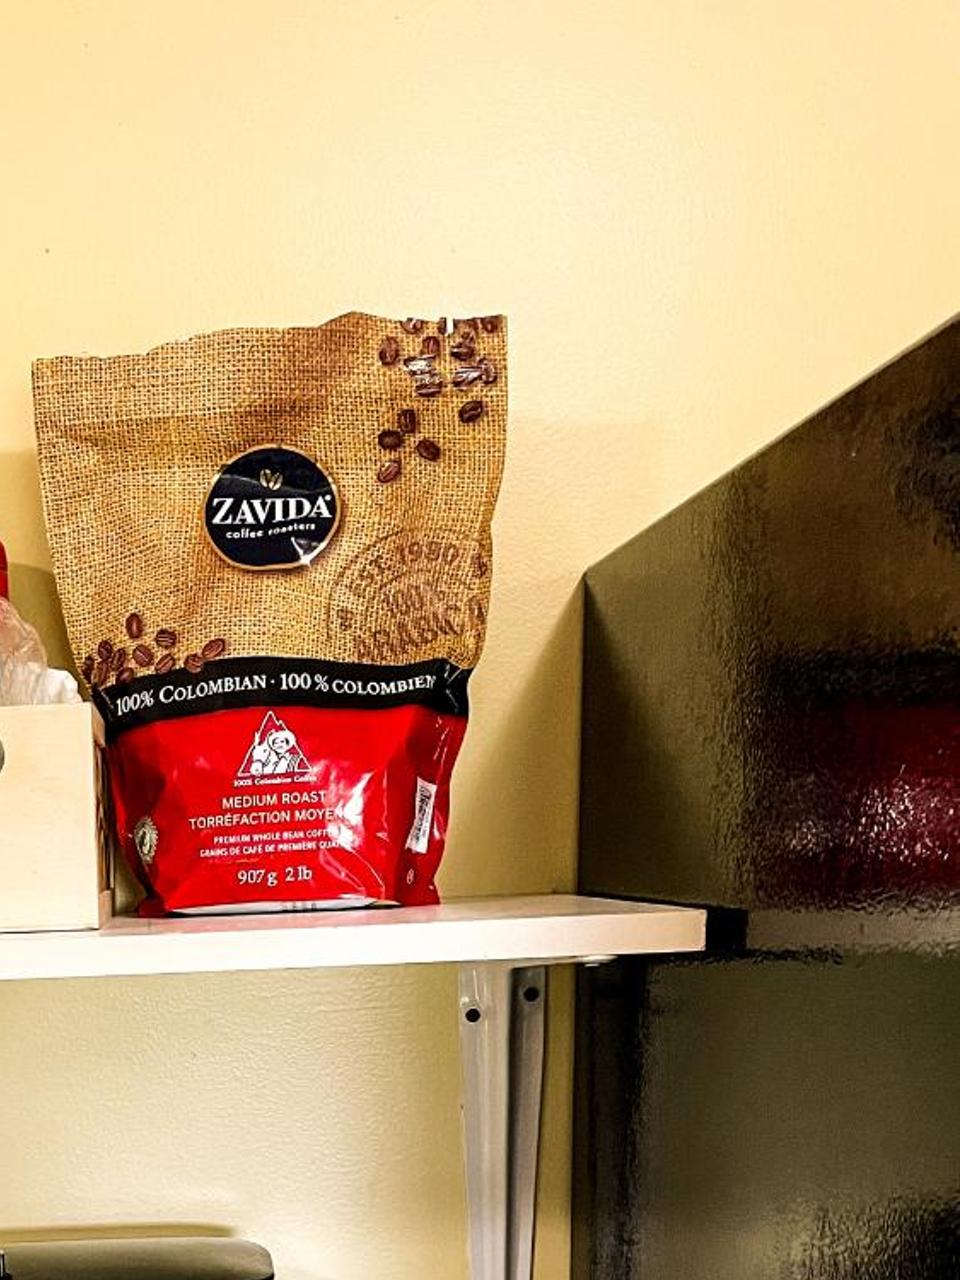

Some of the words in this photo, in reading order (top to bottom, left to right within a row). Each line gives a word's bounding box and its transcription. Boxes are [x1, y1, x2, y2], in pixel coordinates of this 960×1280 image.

[211, 495, 332, 525] ZAVIDA
[226, 528, 265, 539] coffee
[115, 689, 155, 717] 100%
[331, 674, 437, 695] COLOMBIEN
[222, 793, 279, 810] MEDIUM
[281, 790, 327, 805] ROAST
[188, 811, 291, 830] TORRÉFACTION
[252, 831, 281, 843] WHOLE
[199, 847, 229, 858] GRAINS
[229, 846, 241, 857] DE
[242, 843, 262, 856] CAFÉ
[237, 868, 266, 884] 907
[267, 871, 279, 887] g
[284, 868, 296, 882] 2
[297, 865, 313, 880] lb
